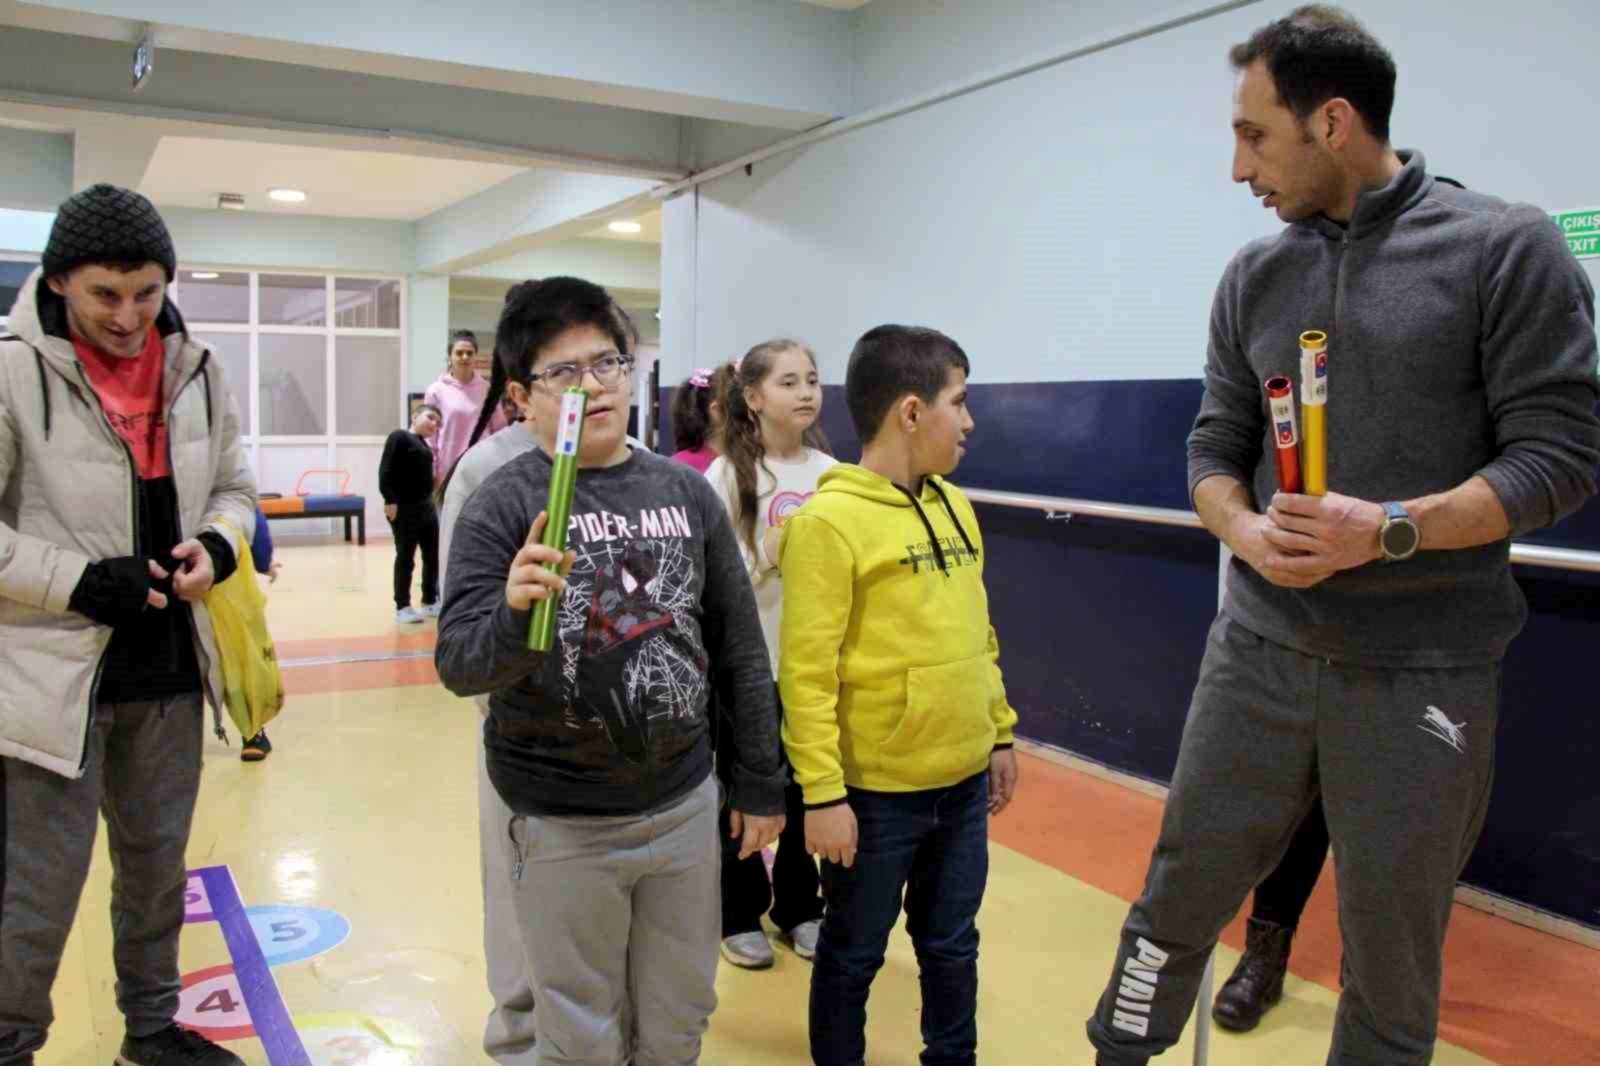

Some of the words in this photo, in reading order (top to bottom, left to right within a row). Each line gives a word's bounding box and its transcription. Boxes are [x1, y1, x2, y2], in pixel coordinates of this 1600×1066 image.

[567, 505, 692, 543] PIDER-MAN
[269, 920, 306, 942] 5
[195, 988, 240, 1013] 4
